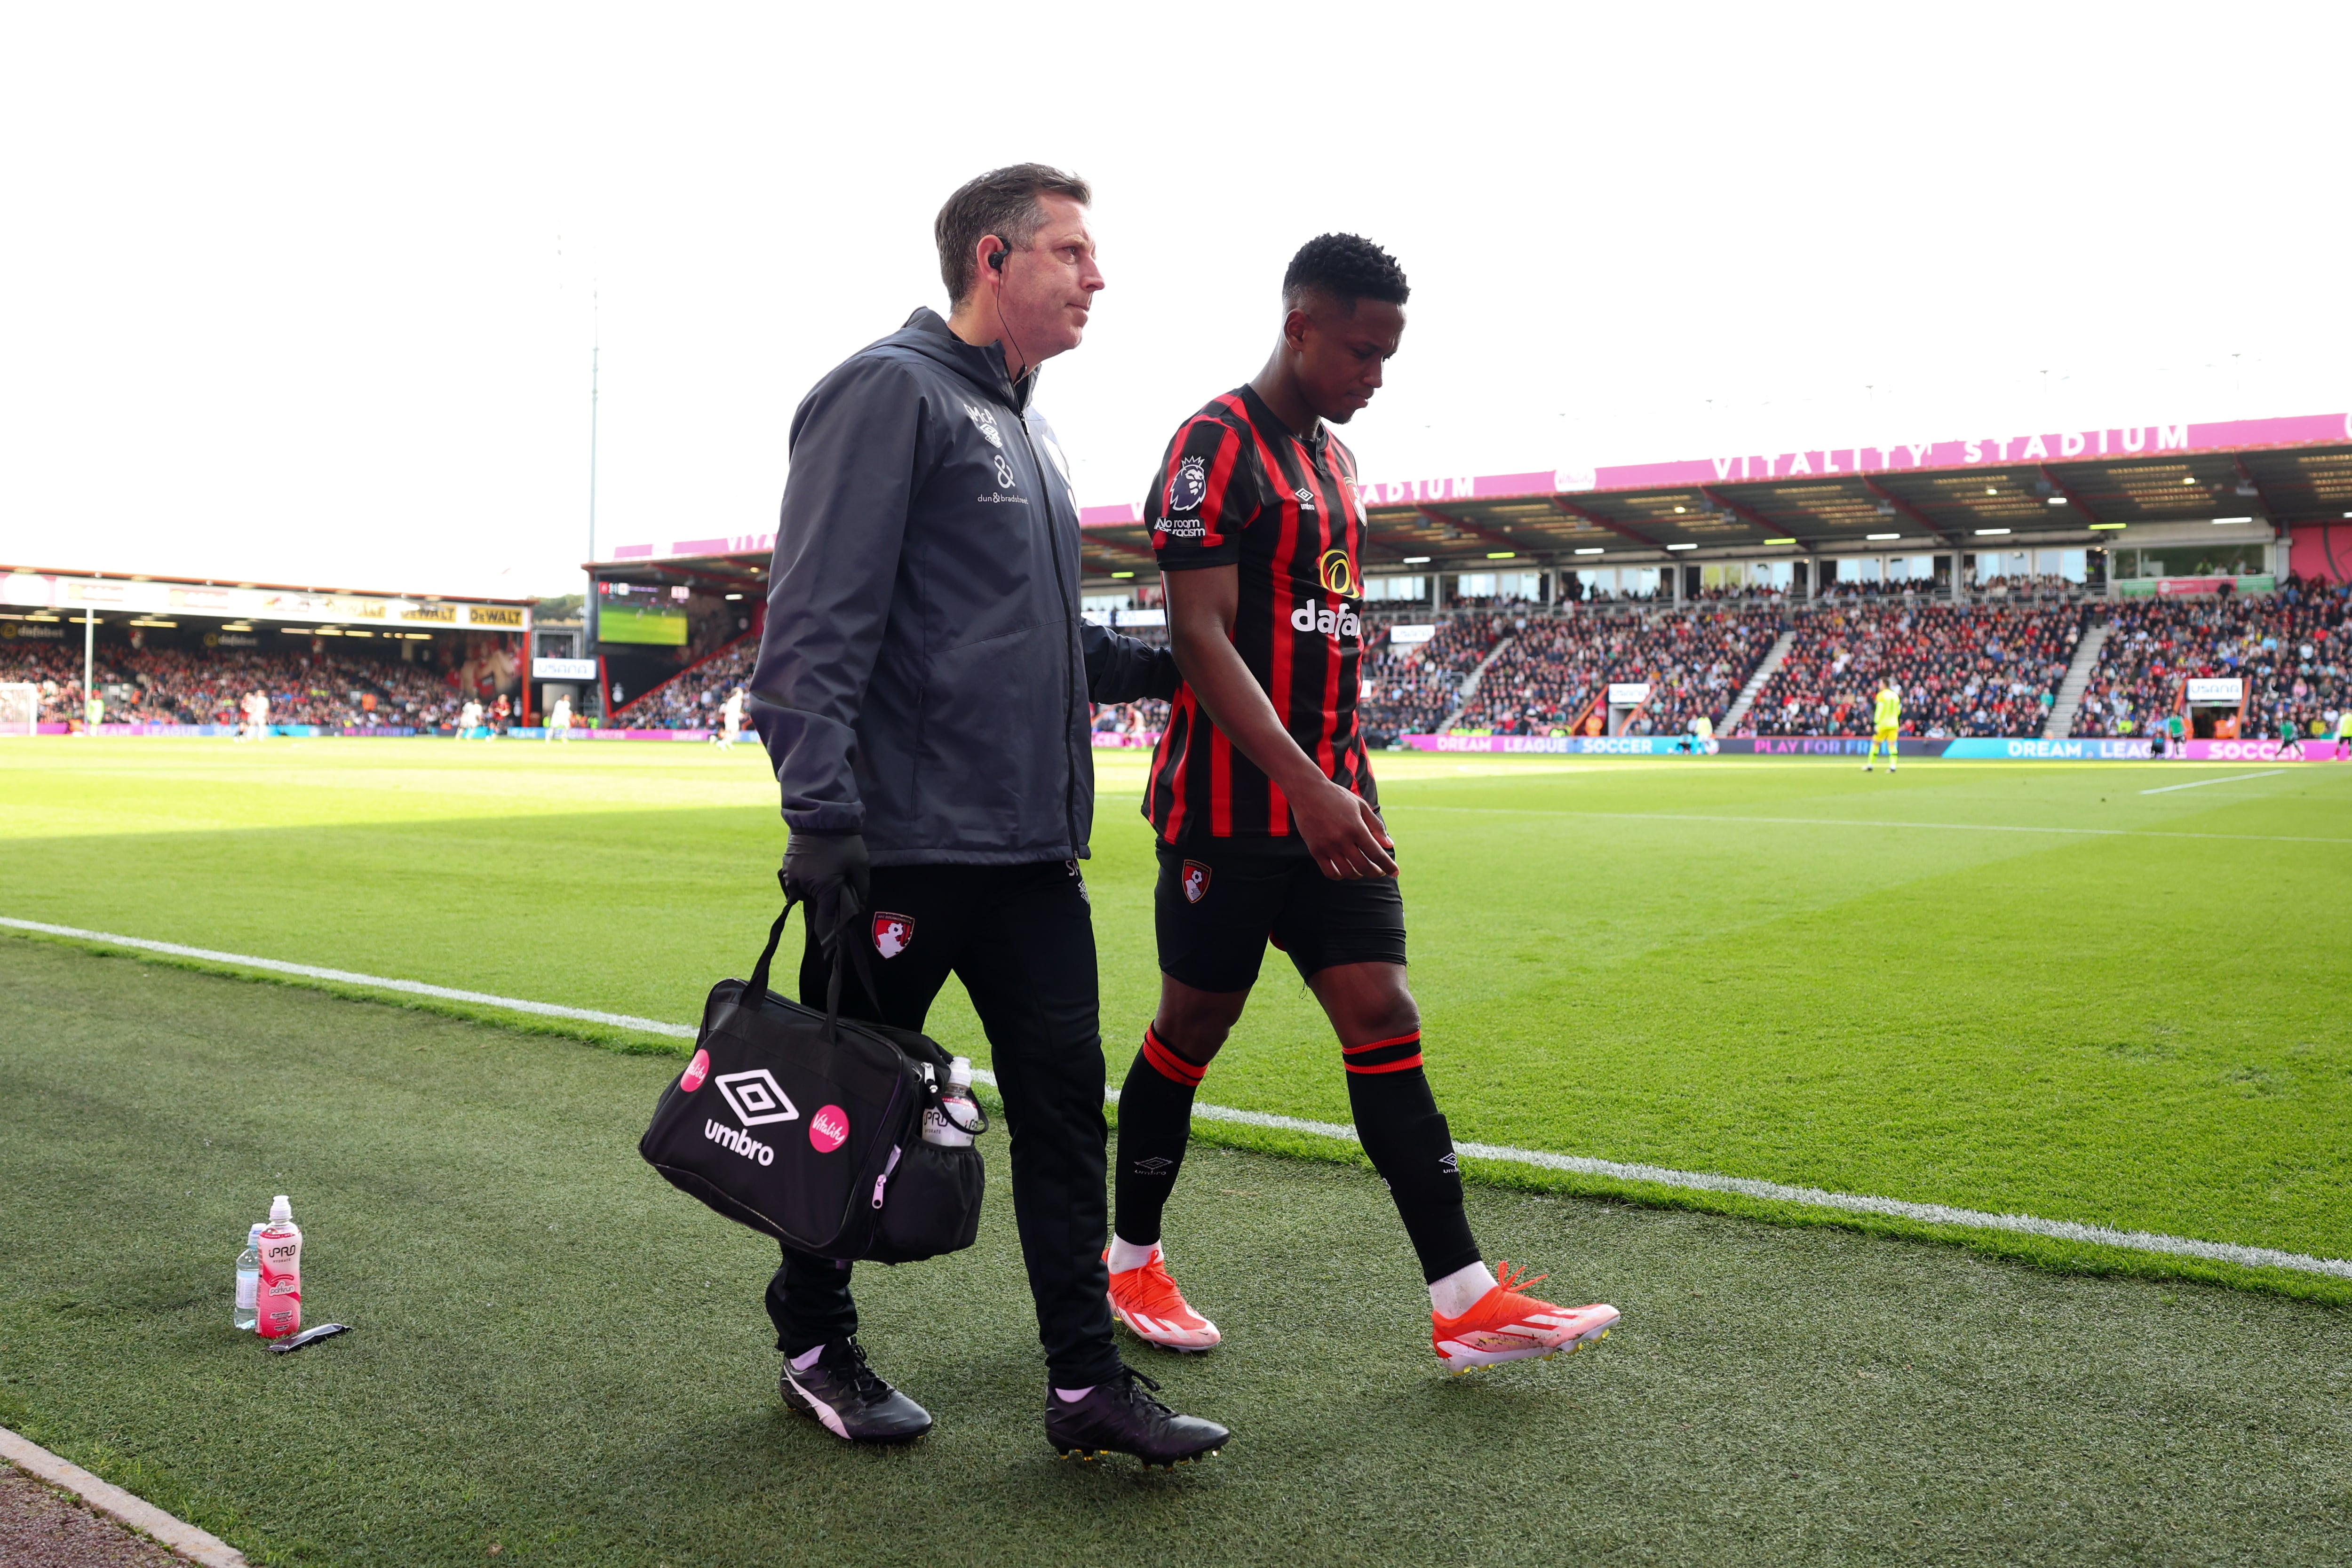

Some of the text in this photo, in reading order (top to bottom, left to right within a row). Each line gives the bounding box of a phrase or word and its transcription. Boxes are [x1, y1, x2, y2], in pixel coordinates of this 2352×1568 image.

[1711, 425, 2188, 479] VITALITY STADIUM
[1300, 502, 1315, 511] umbro
[1156, 517, 1200, 528] No room
[1172, 528, 1206, 537] racism
[1291, 598, 1361, 642] dafa
[1437, 737, 1653, 754] DREAM LEAGUE SOCCER
[1754, 740, 1798, 754] PLAY
[1803, 740, 1841, 754] FOR
[2008, 741, 2082, 757] DREAM
[812, 1114, 845, 1146] Vitality
[704, 1119, 774, 1166] umbro
